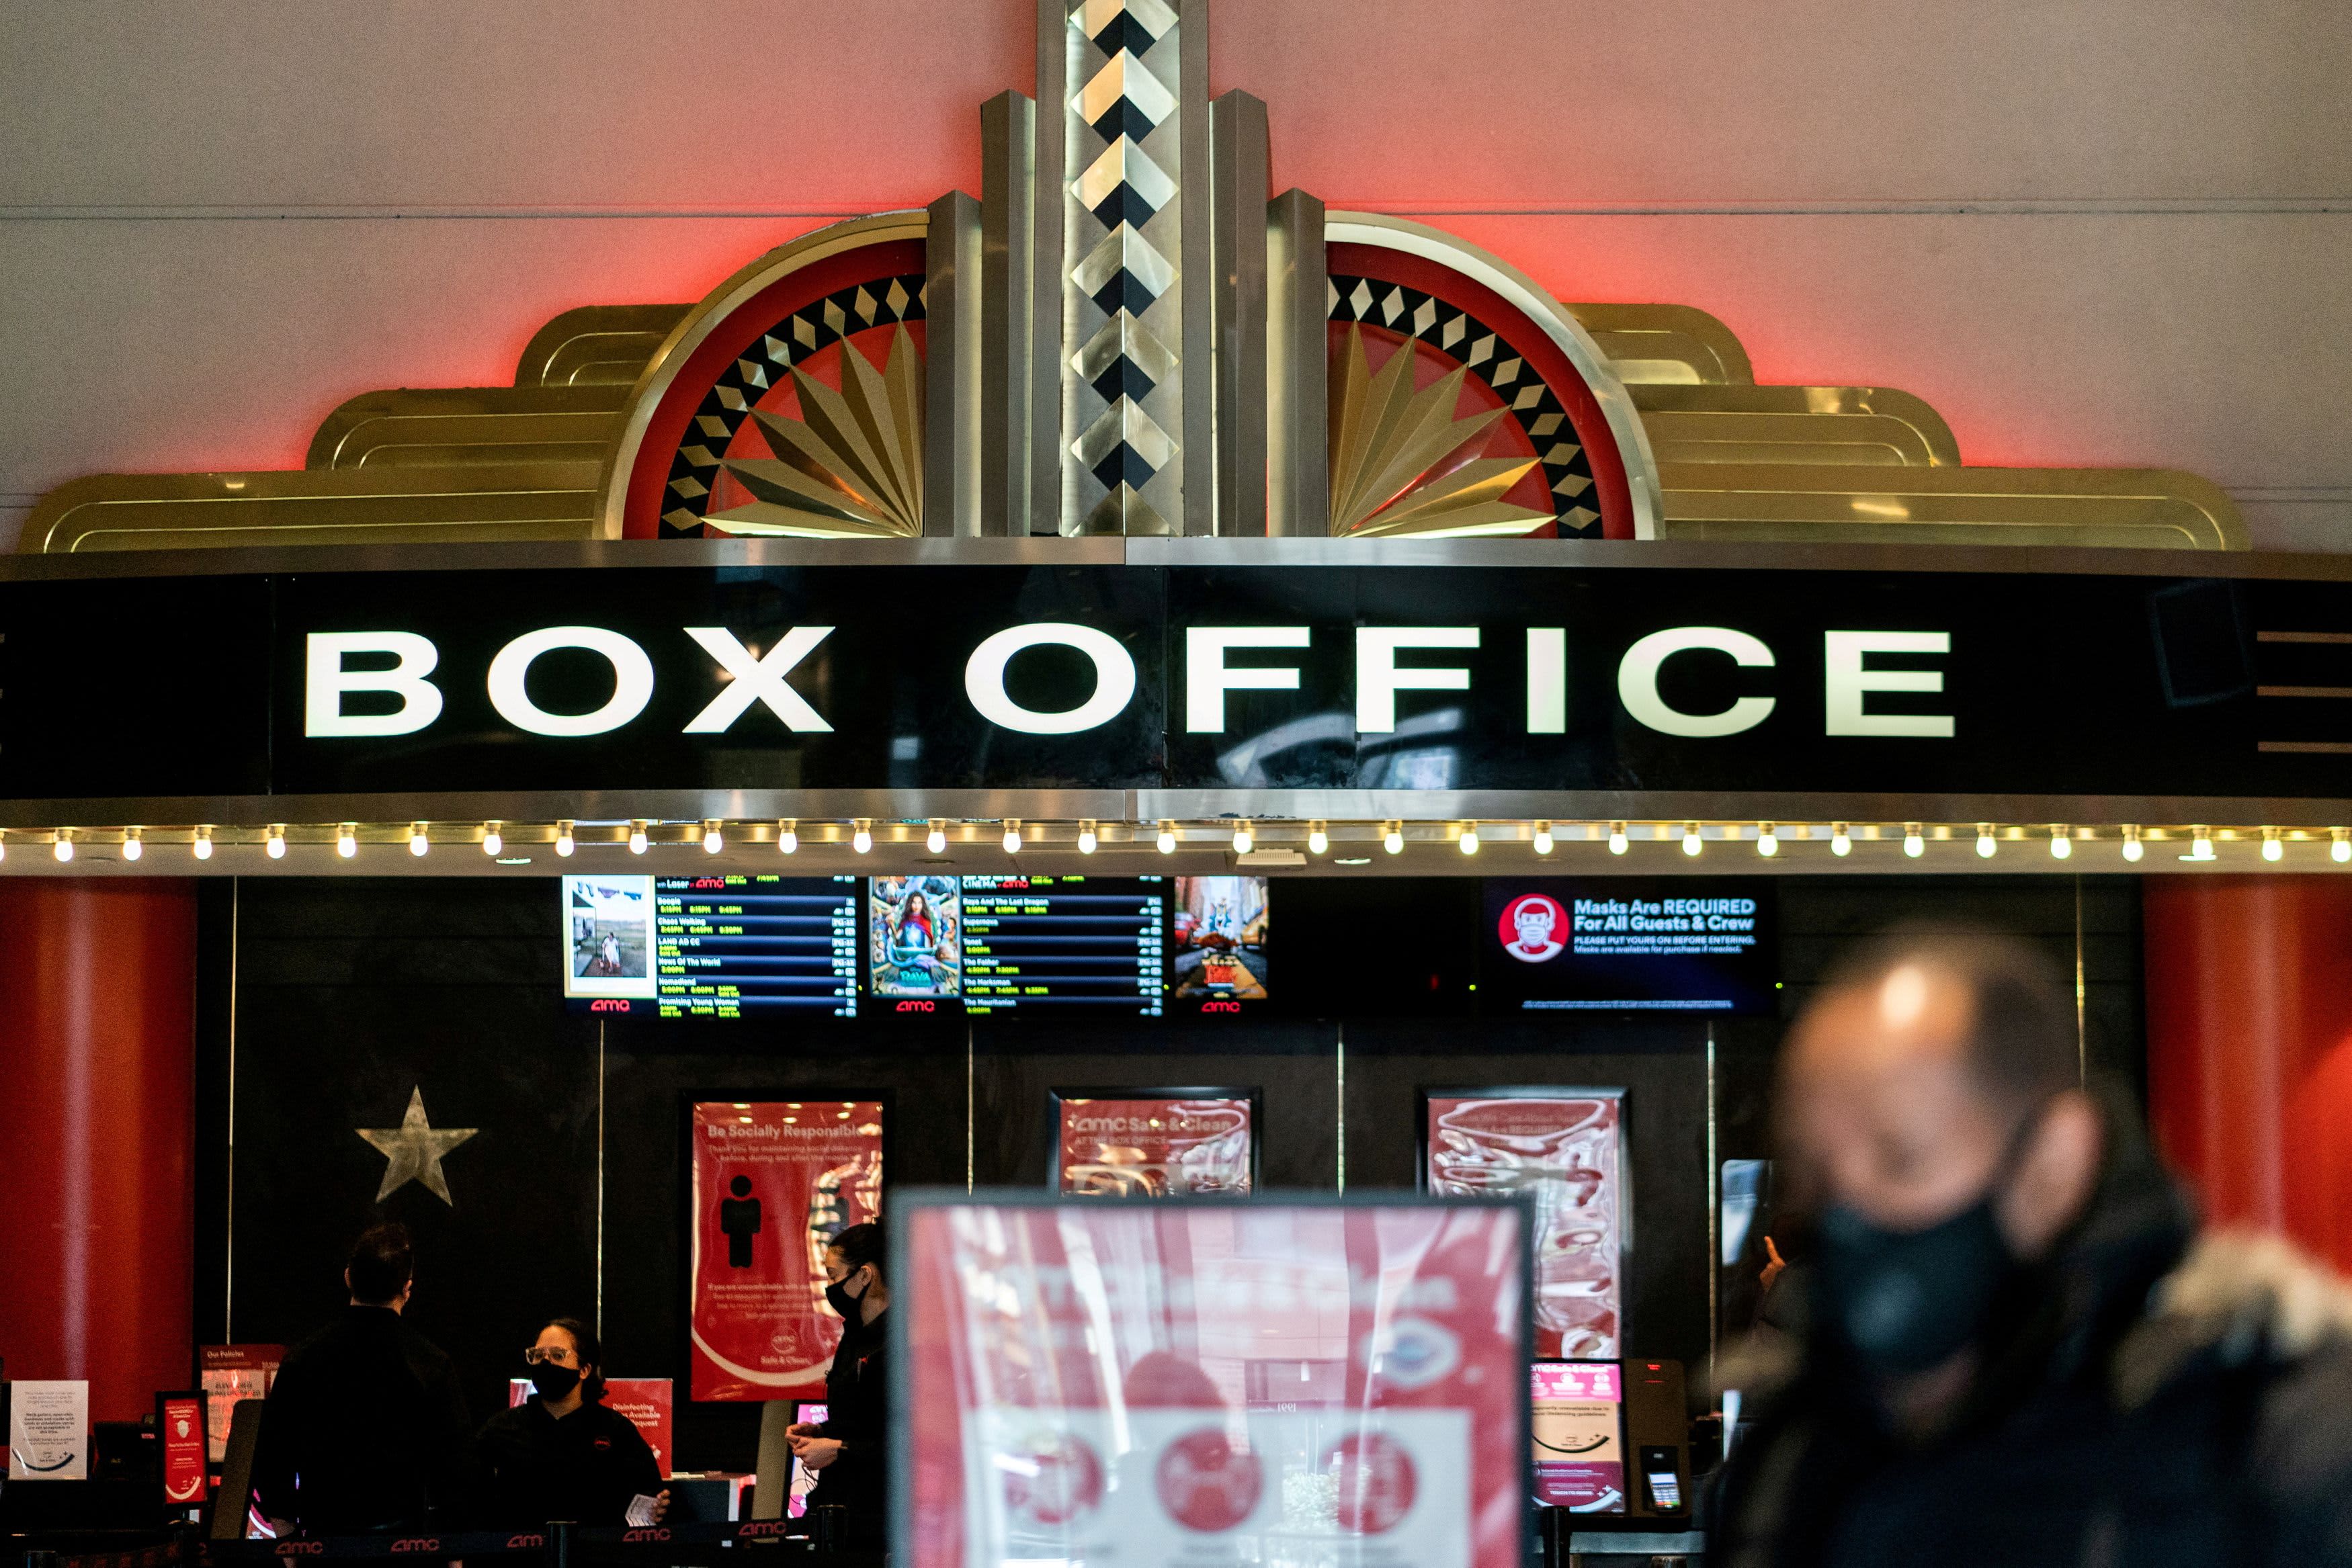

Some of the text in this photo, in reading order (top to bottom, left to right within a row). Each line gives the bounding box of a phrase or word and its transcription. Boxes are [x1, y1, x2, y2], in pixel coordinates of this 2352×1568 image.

[306, 622, 1955, 738] BOX OFFICE
[667, 879, 689, 889] Laser
[696, 879, 725, 889] amc
[962, 880, 1029, 889] CINEMA amc
[657, 897, 681, 906] Boogie
[962, 898, 1050, 906] Raya And The Last Dragon
[1574, 899, 1756, 915] Masks Are REQUIRED
[657, 917, 706, 926] Chaos Walking
[963, 918, 999, 926] Supernova
[1574, 916, 1755, 931] For All Guests & Crew
[658, 938, 700, 946] LAND AD CC
[963, 938, 982, 946] Tenet
[1574, 936, 1606, 945] PLEASE
[1607, 936, 1624, 945] PUT
[1625, 936, 1656, 945] YOURS
[1656, 936, 1671, 945] ON
[1673, 936, 1707, 945] BEFORE
[1574, 946, 1599, 954] Masks
[1614, 946, 1650, 954] available
[1650, 946, 1662, 954] for
[1663, 946, 1700, 955] purchase
[1701, 946, 1708, 954] if
[658, 957, 721, 967] News Of The World
[659, 977, 696, 986] Nomadland
[964, 978, 1011, 986] The Marksman
[591, 1000, 630, 1012] amc
[659, 998, 740, 1006] Promising Young Woman
[896, 1000, 935, 1012] amc
[964, 998, 1017, 1007] The Mauritanian
[1200, 1002, 1241, 1013] amc
[1075, 1117, 1127, 1133] amc
[1169, 1117, 1181, 1132] &
[708, 1125, 726, 1137] Be
[728, 1125, 780, 1139] Socially
[612, 1403, 655, 1412] Disinfecting
[629, 1411, 661, 1419] Available
[739, 1522, 787, 1537] amc
[622, 1528, 671, 1542] amc
[391, 1538, 439, 1553] amc
[506, 1534, 544, 1549] am
[275, 1541, 323, 1555] amc
